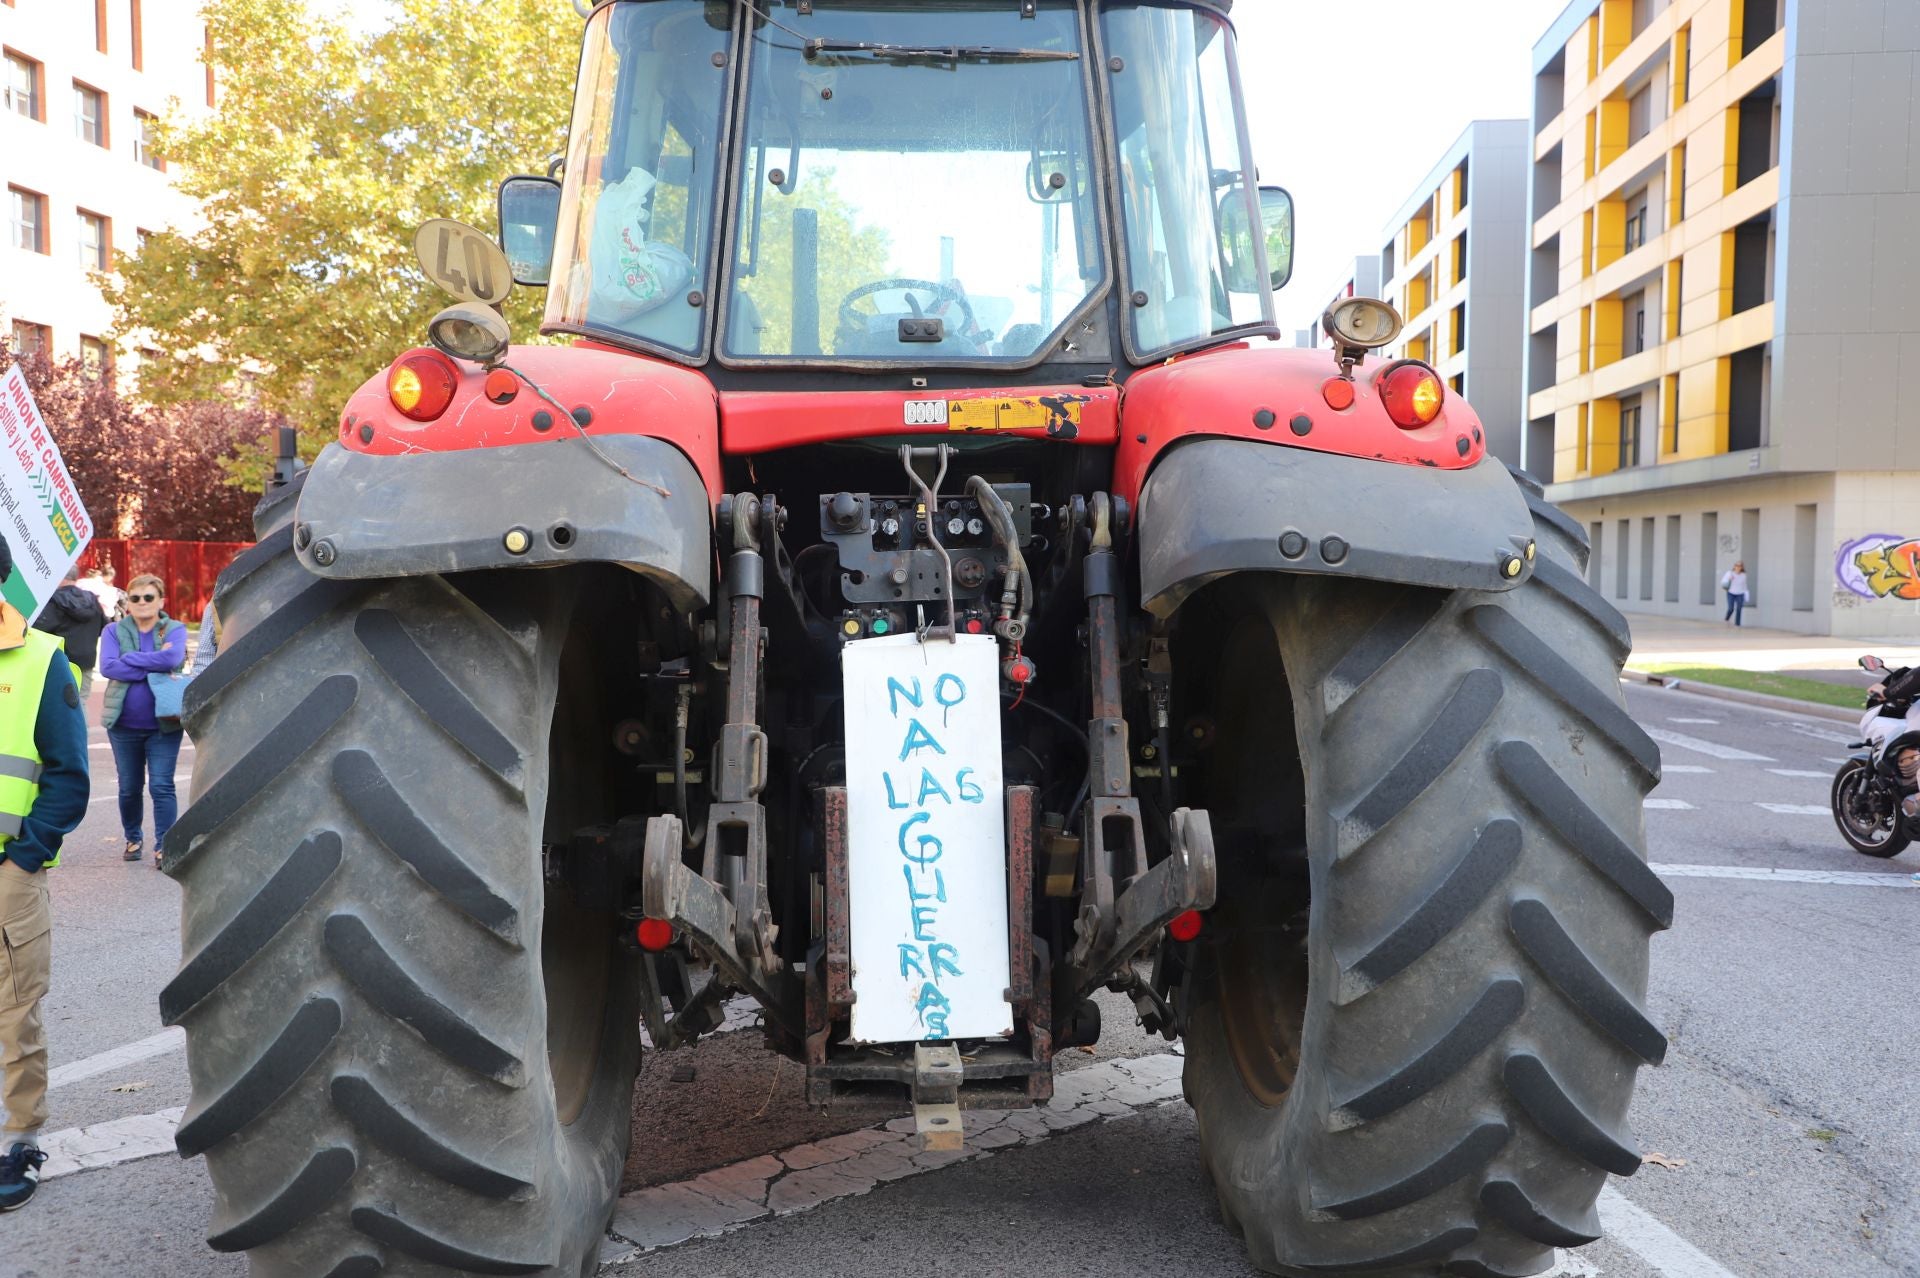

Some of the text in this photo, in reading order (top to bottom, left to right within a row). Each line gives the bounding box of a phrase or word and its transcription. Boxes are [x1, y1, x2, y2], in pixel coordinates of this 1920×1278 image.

[436, 227, 494, 300] 40
[8, 375, 88, 539] UNION DE CAMPESINOS
[9, 433, 20, 449] y
[16, 440, 34, 474] León
[0, 473, 52, 580] ncipal, como siempre
[887, 673, 966, 722] NO
[899, 718, 946, 762] A
